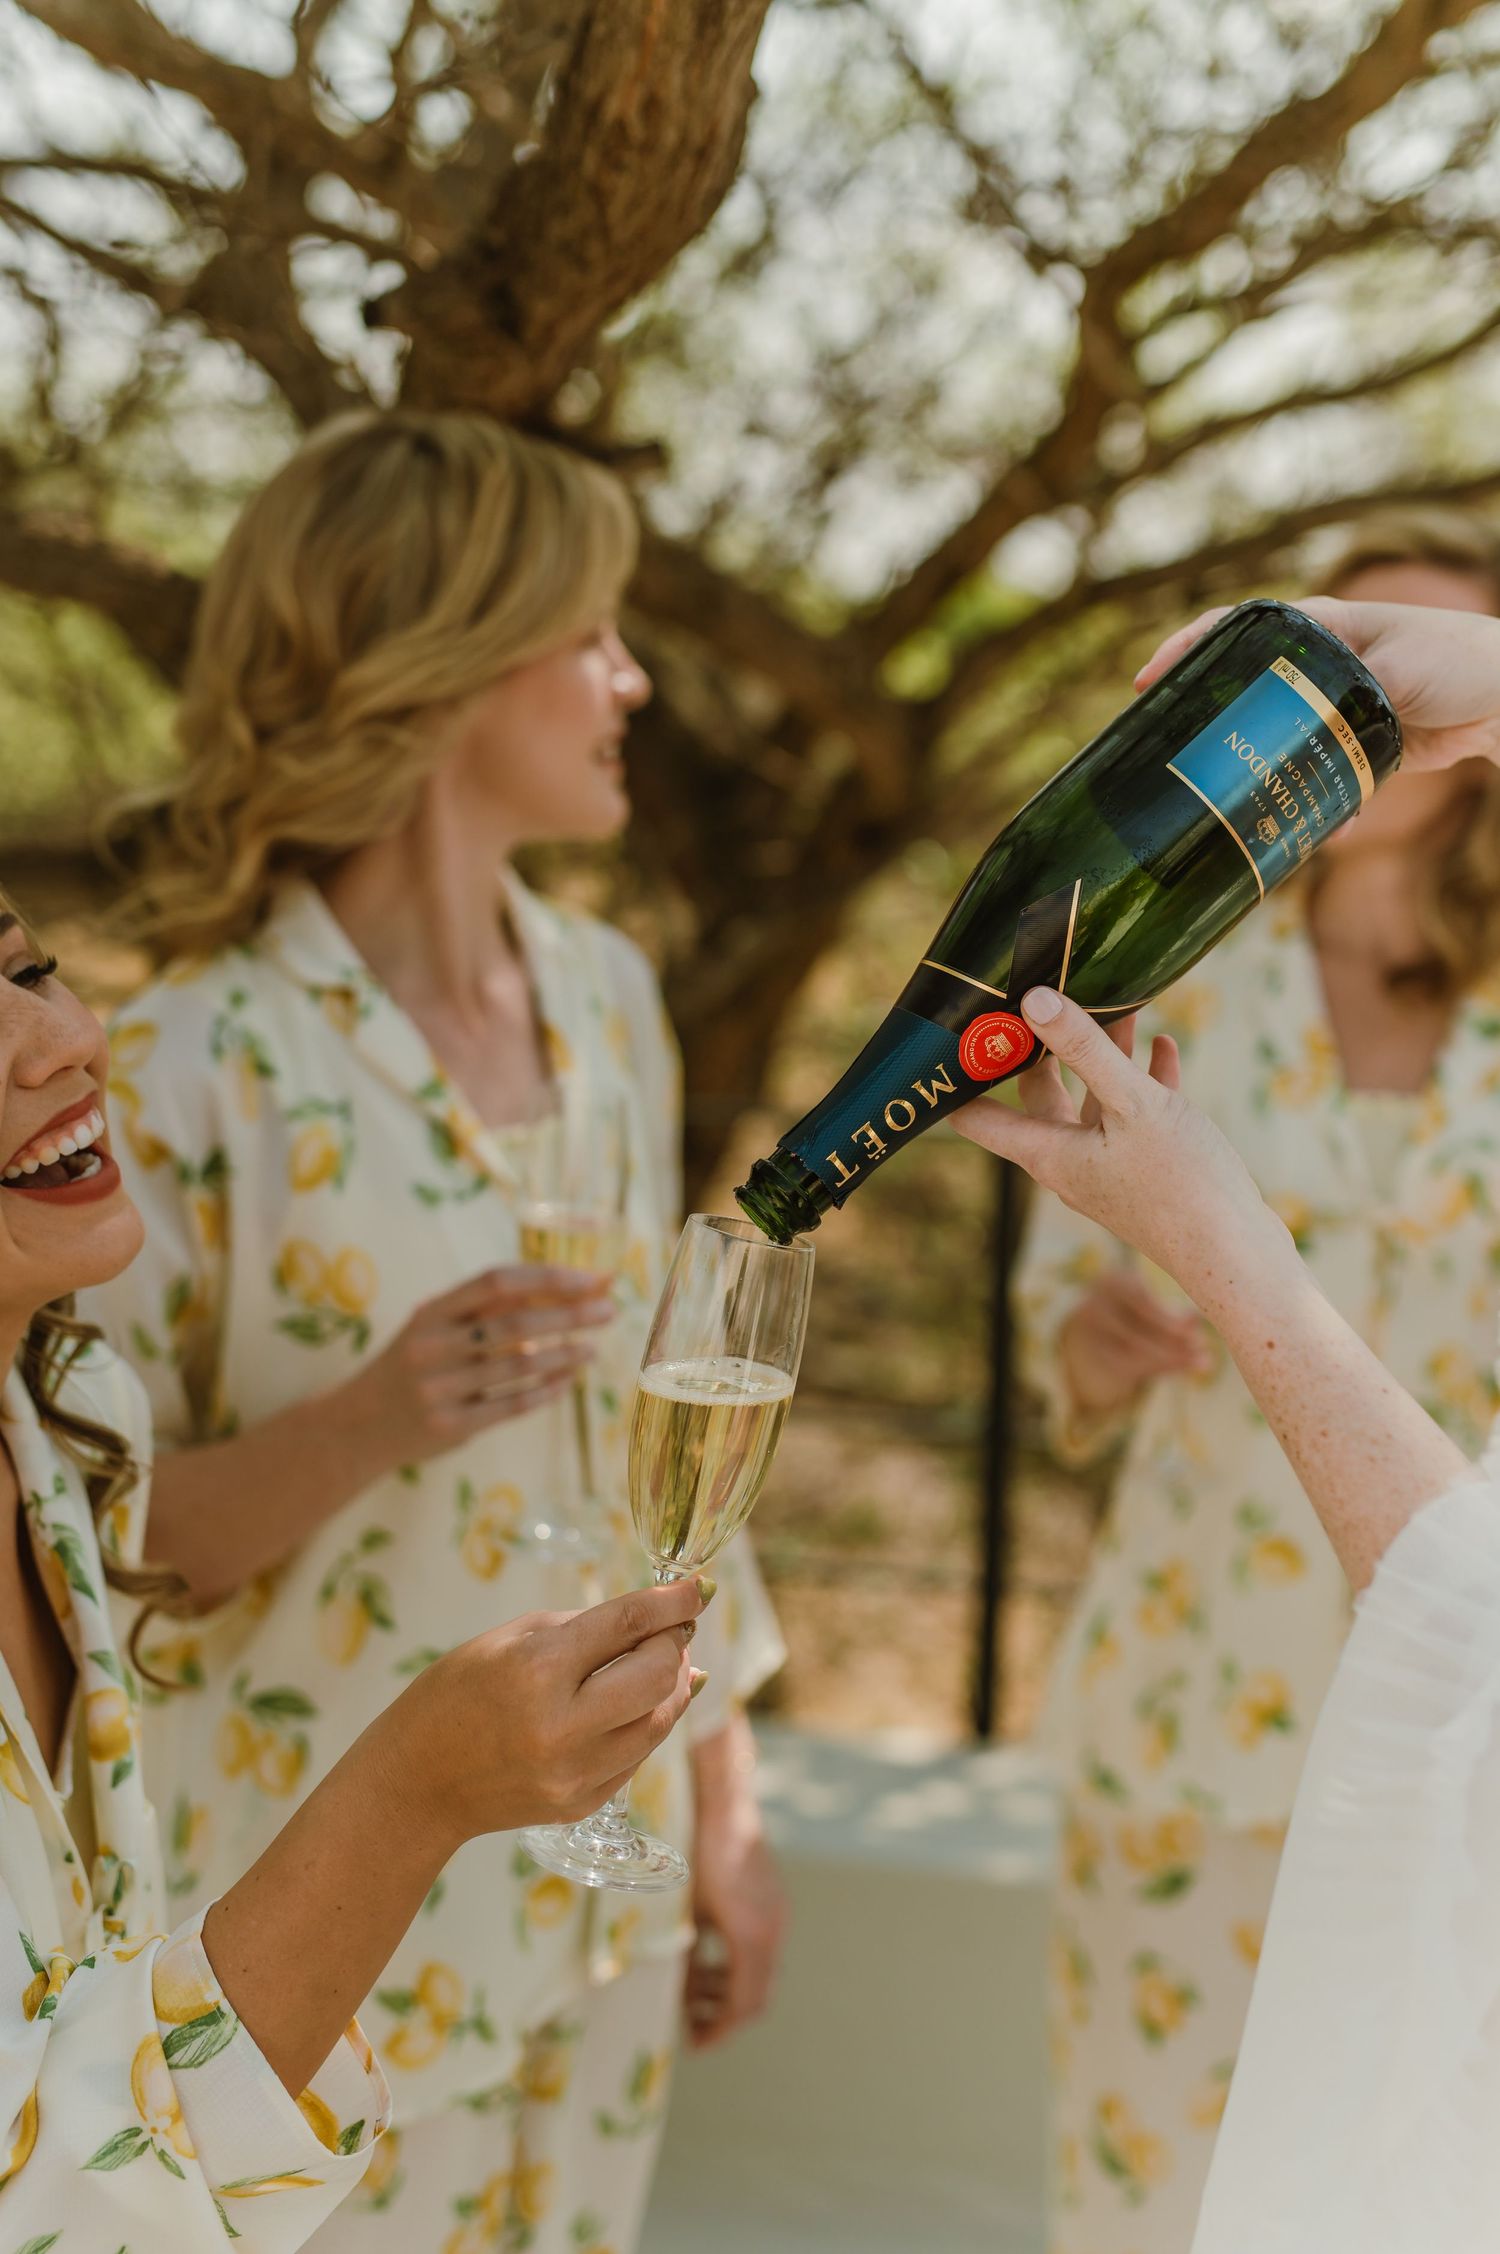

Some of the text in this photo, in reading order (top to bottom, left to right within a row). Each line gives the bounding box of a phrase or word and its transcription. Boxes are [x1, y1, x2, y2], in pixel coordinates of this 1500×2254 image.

[1285, 670, 1301, 685] 750
[1295, 716, 1336, 774] IMPÉRIAL
[1337, 724, 1366, 771] DEMI-SEC
[1223, 731, 1299, 820] CHANDON
[1277, 752, 1325, 827] CHAMPAGNE
[1250, 790, 1267, 812] 1743
[1293, 815, 1307, 834] &
[969, 1037, 979, 1068] CHANDON
[825, 1063, 958, 1188] MOËT
